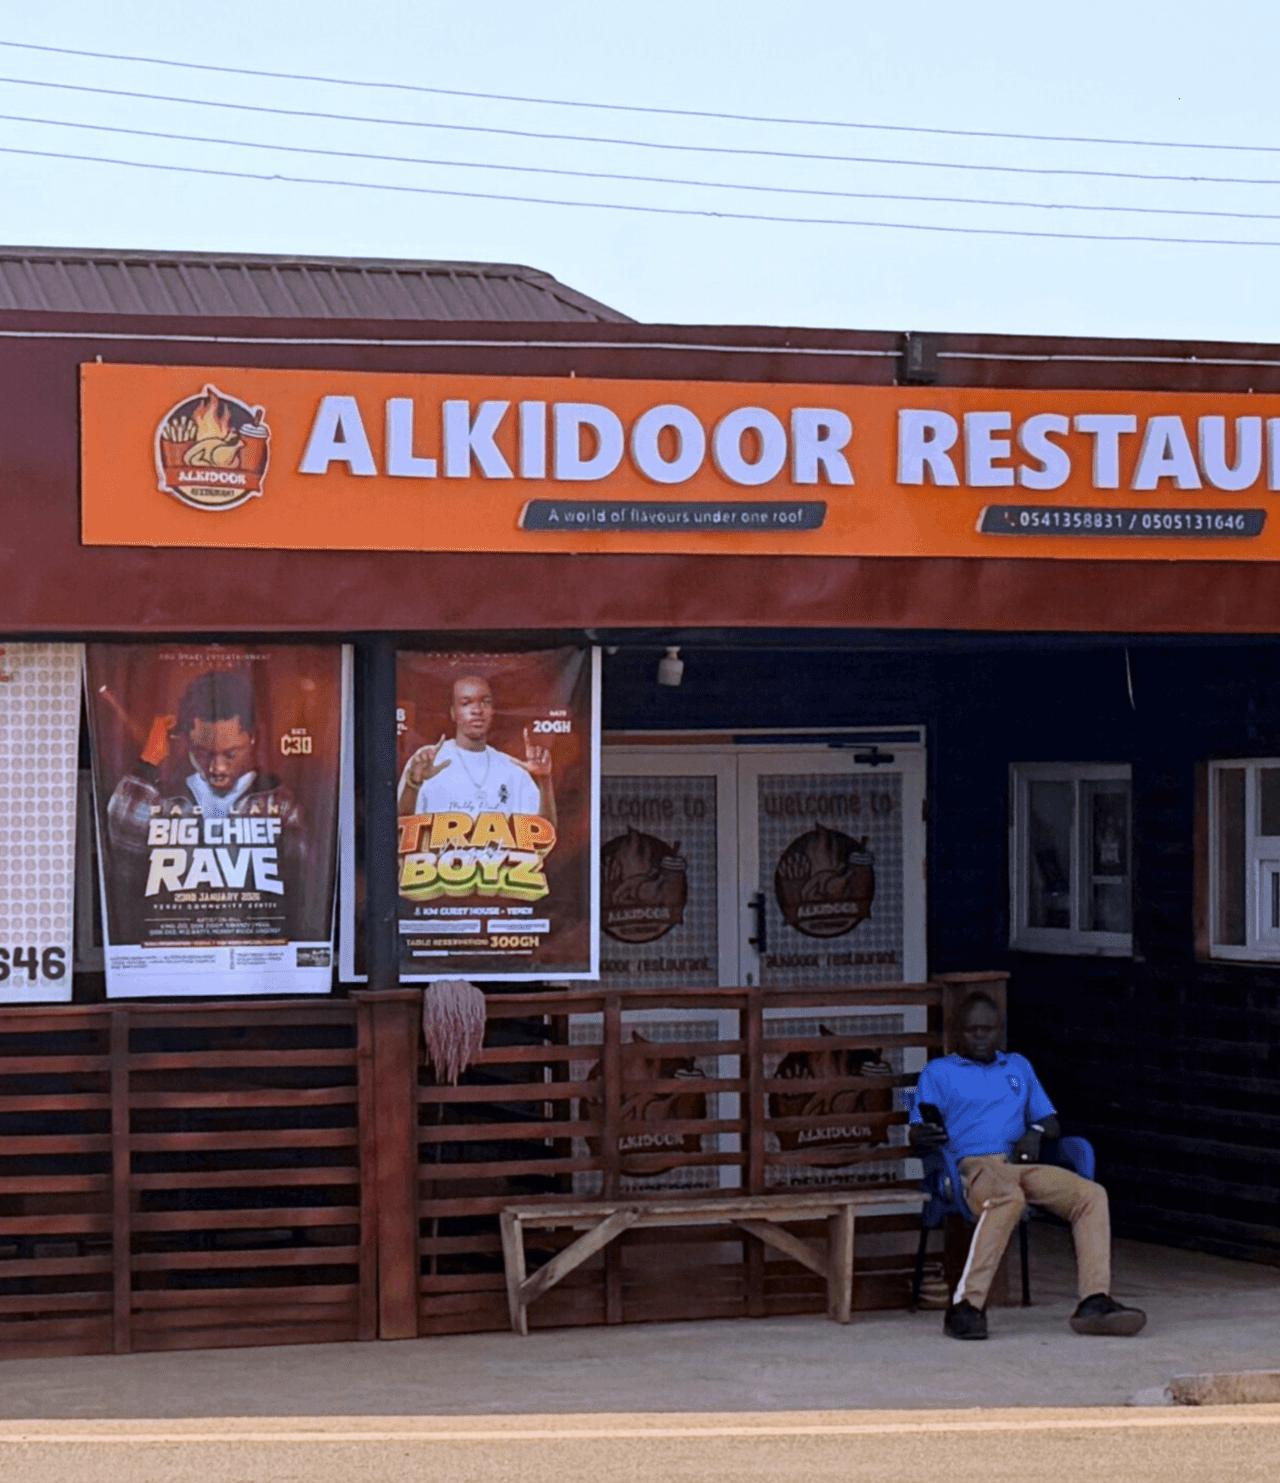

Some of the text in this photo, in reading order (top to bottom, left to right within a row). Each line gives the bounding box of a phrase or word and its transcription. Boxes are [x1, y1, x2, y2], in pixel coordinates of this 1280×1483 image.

[299, 395, 854, 485] ALKIDOOR
[178, 470, 246, 485] ALKIDOOR
[548, 508, 804, 524] A world of flavours under one roof
[1020, 511, 1245, 531] 0541358831 / 0505131646
[532, 720, 572, 734] 20GH
[600, 793, 705, 820] lcome to
[764, 790, 892, 817] welcome to
[147, 817, 282, 846] BIG CHIEF
[398, 811, 557, 853] TRAP
[145, 847, 284, 897] RAVE
[398, 849, 550, 900] BOYZ
[198, 892, 240, 902] JANUARY
[406, 939, 431, 947] TABLE
[489, 936, 540, 948] 300GH
